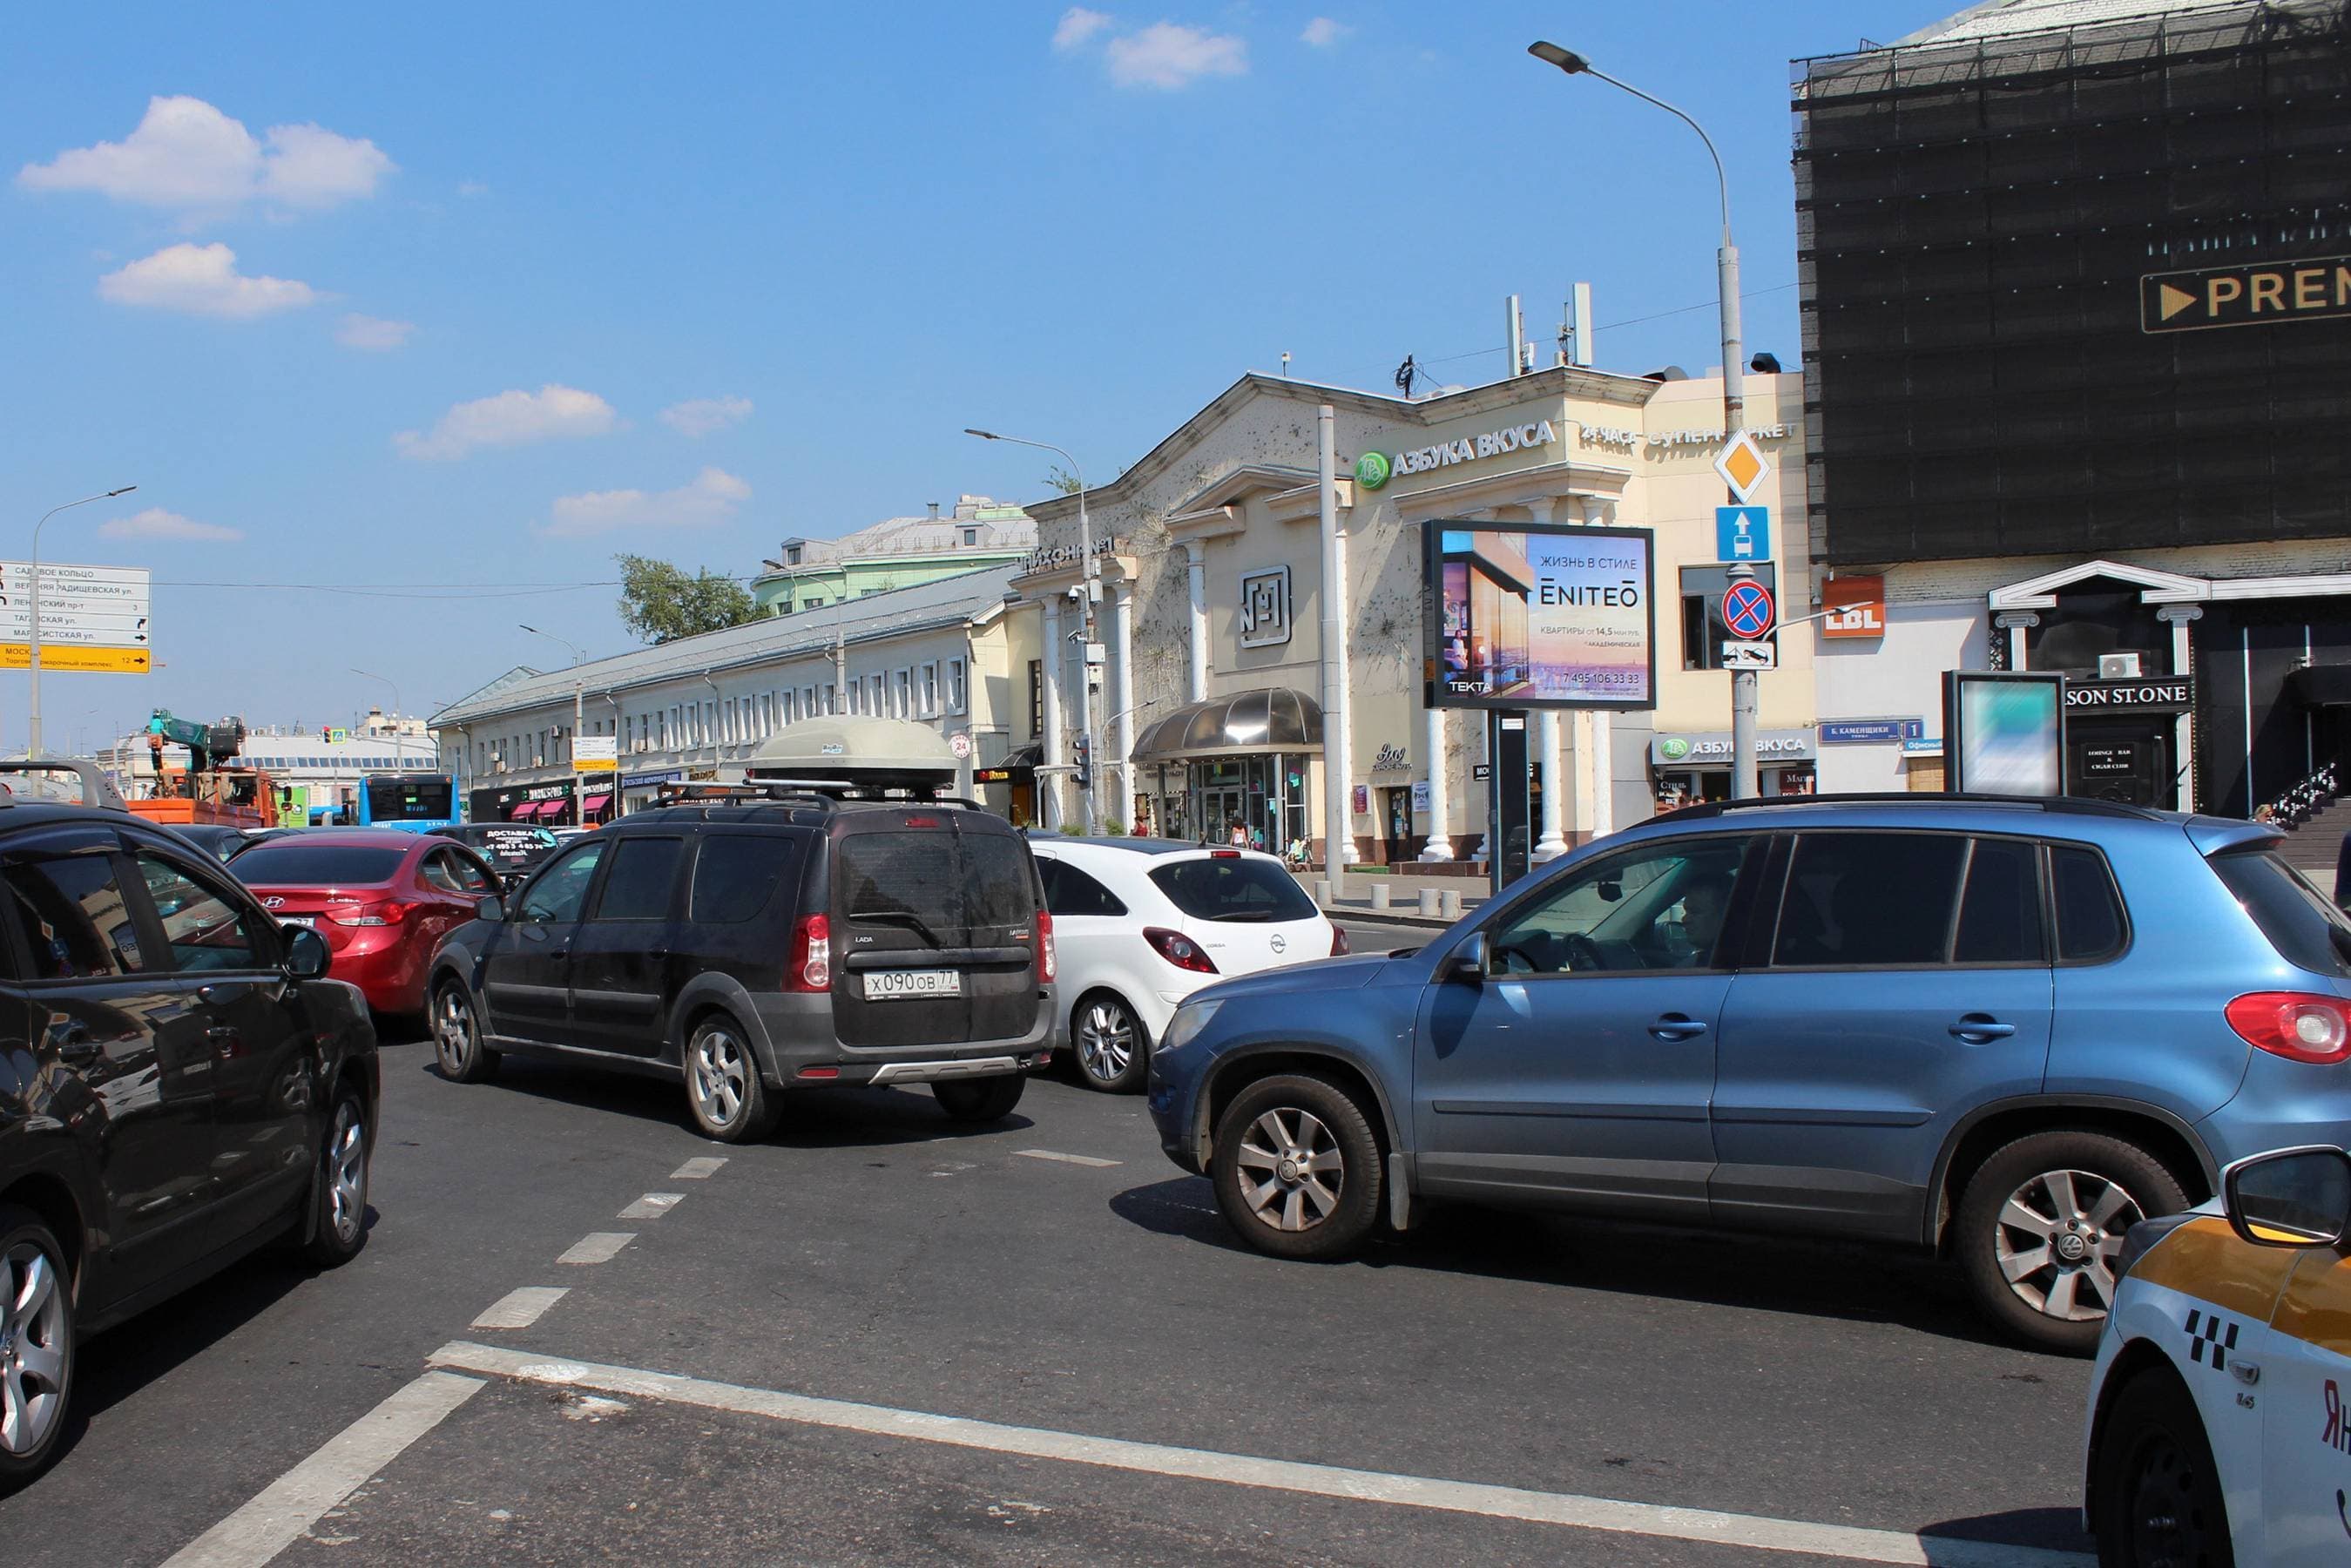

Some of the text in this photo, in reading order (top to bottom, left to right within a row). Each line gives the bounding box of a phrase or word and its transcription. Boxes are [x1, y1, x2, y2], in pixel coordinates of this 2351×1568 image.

[1599, 426, 1637, 445] ЧАСА
[1391, 420, 1557, 477] АЗБУКА ВКУСА
[1540, 556, 1638, 570] ЖИЗНЬ В СТИЛЕ
[58, 567, 94, 578] КОЛЬЦО
[13, 598, 65, 608] ЛЕННСКИЙ
[14, 614, 64, 624] ТАГСКАЯ
[1824, 609, 1881, 631] LBL
[1540, 626, 1585, 635] КВАРТИРЫ
[1596, 627, 1613, 637] 14,5
[1571, 673, 1591, 684] 495
[1593, 673, 1611, 684] 106
[1613, 674, 1625, 684] 33
[1627, 674, 1639, 684] 33
[2064, 689, 2108, 706] SON
[1840, 726, 1889, 735] КАМЕНЩИКИ
[1911, 725, 1917, 737] 1
[1756, 738, 1806, 753] ВКУСА
[939, 970, 953, 984] 77
